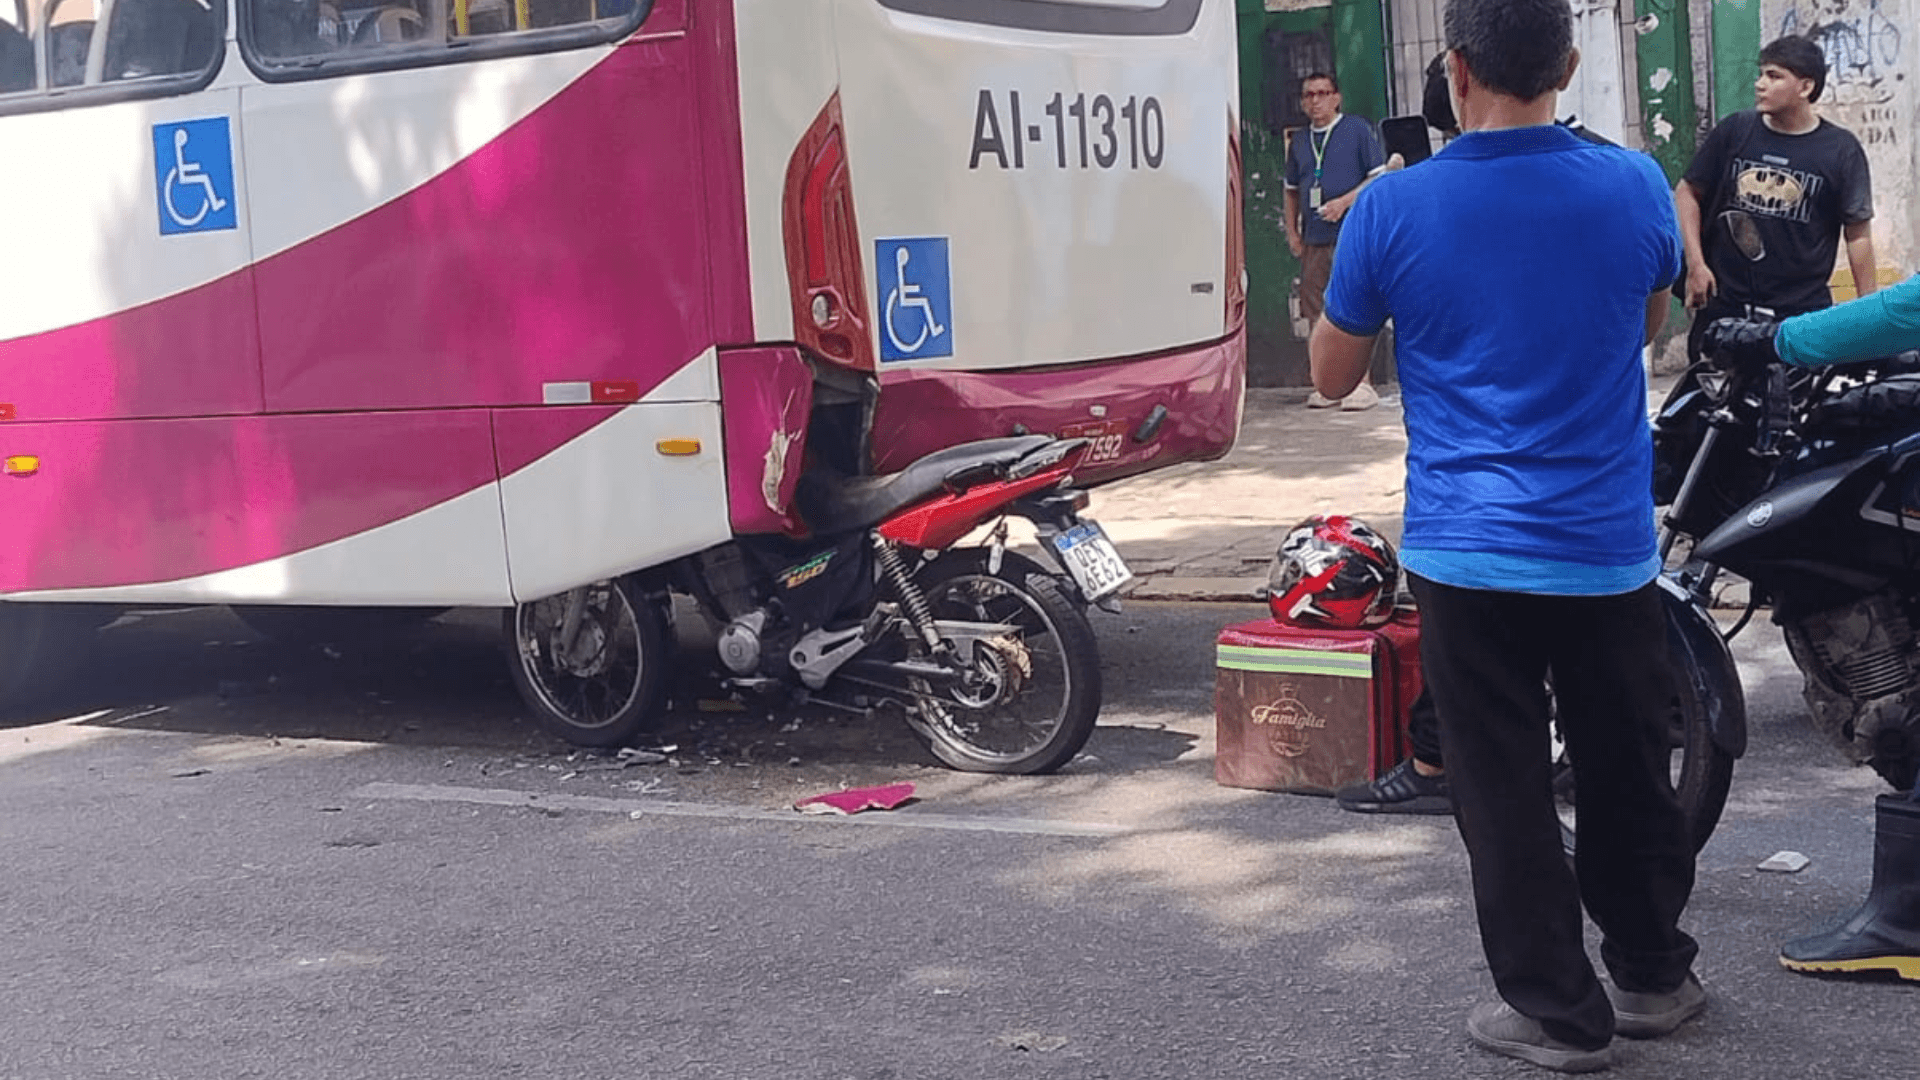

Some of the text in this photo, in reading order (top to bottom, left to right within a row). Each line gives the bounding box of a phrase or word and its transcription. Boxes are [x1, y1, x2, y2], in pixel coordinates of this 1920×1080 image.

[969, 89, 1164, 169] AI-11310
[1085, 558, 1123, 591] 6E62
[1251, 704, 1327, 730] Famiglia
